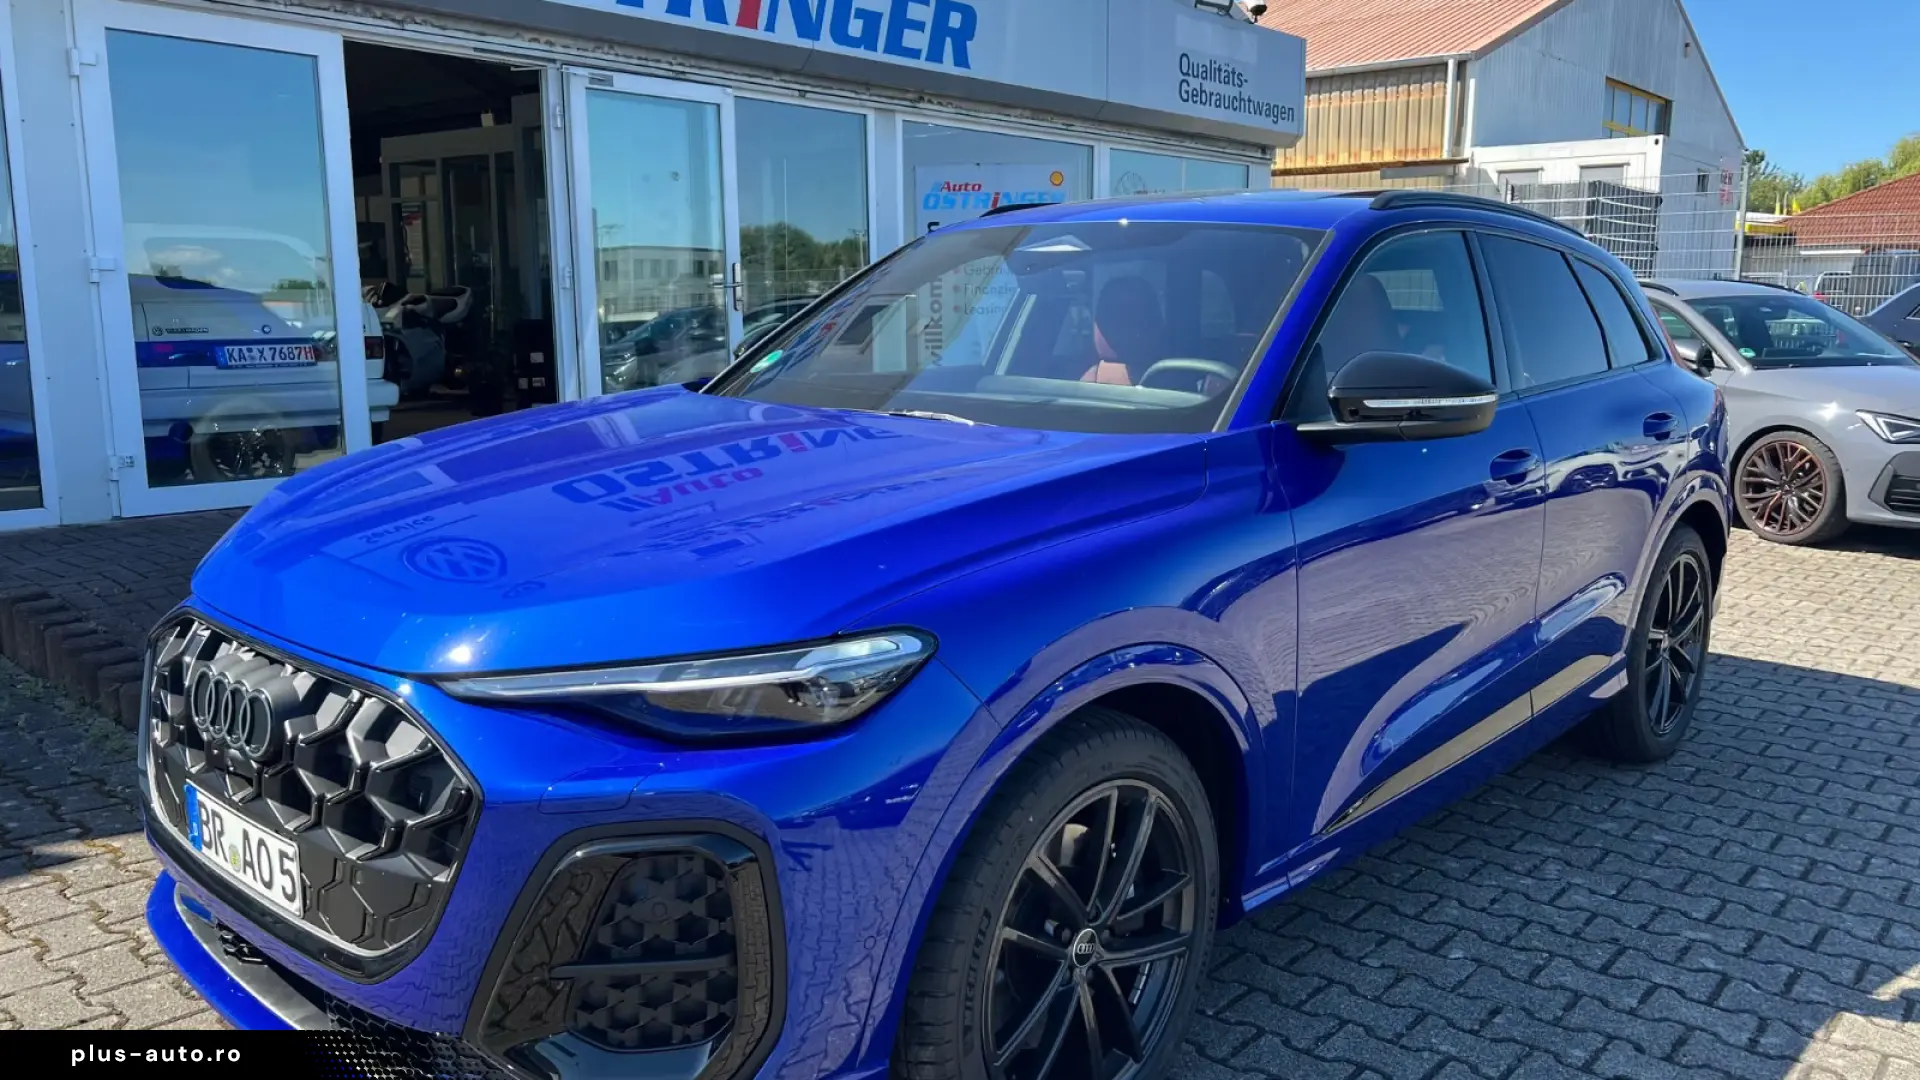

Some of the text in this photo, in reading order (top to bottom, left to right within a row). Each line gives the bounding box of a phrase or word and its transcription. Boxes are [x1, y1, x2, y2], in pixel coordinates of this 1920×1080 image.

[1179, 52, 1249, 89] Qualitäts-
[1178, 78, 1295, 125] Gebrauchtwagen
[940, 181, 983, 193] Auto
[226, 347, 247, 363] KA
[199, 799, 229, 863] BR
